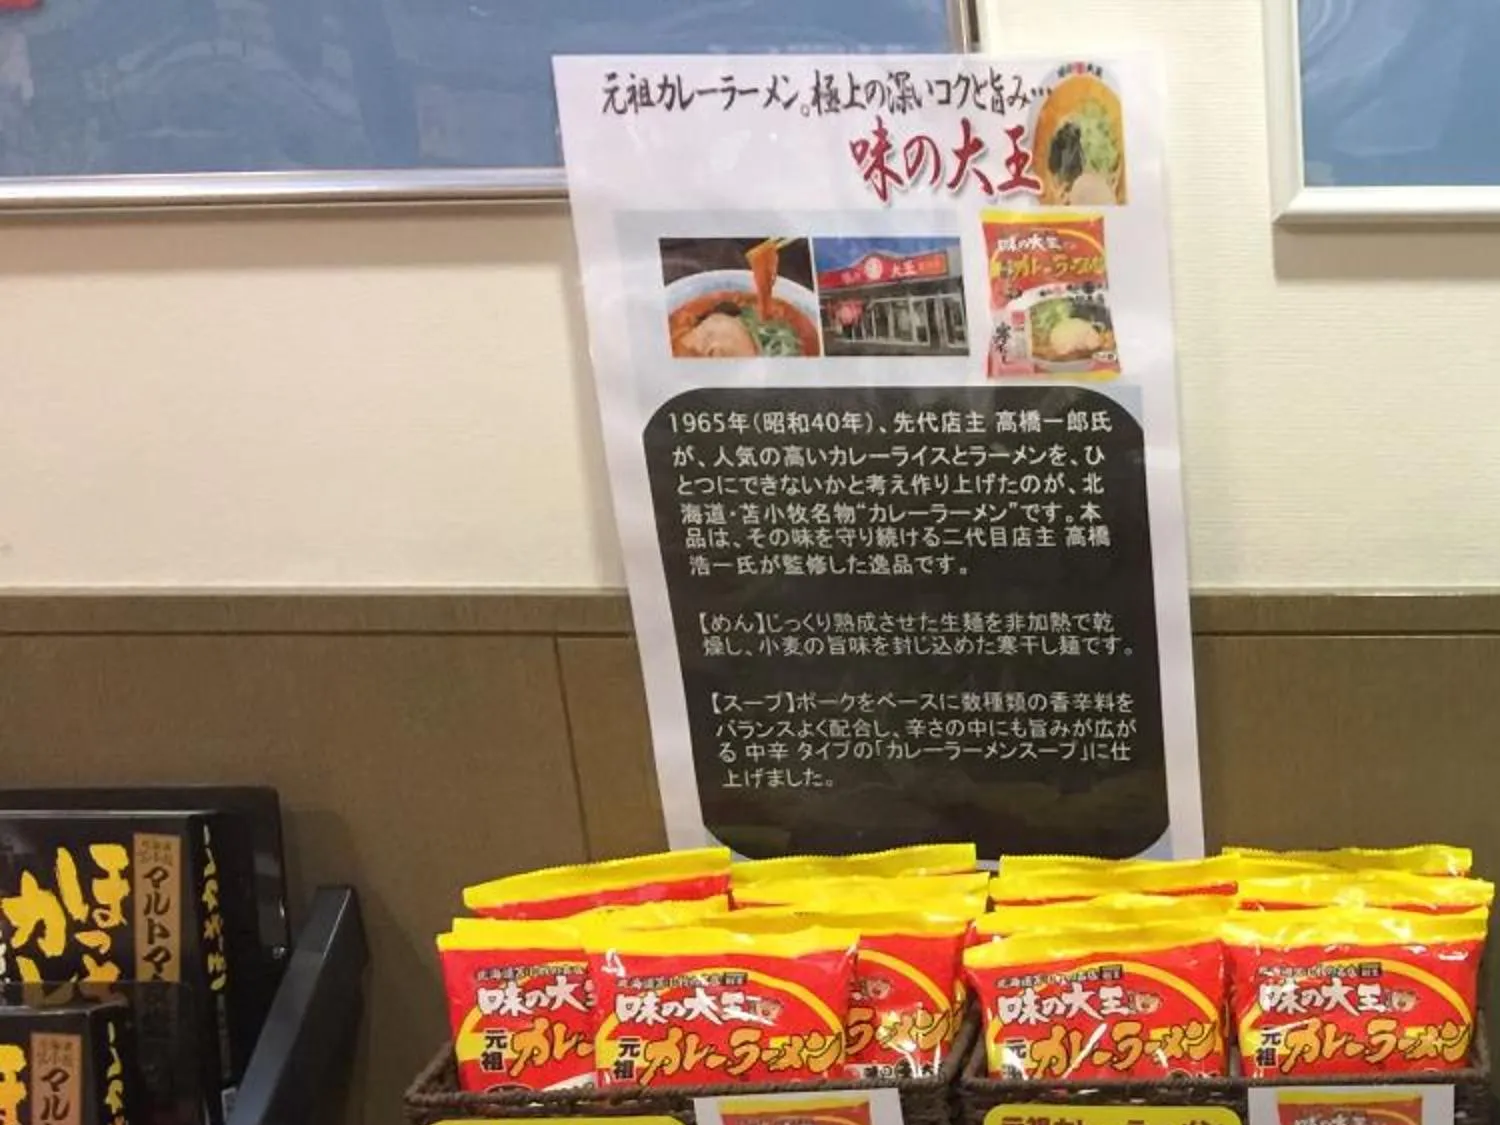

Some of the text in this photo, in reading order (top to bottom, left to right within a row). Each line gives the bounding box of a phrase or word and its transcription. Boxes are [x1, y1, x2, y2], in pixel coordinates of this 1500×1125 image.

[849, 117, 1043, 201] 味の大王
[673, 444, 1105, 468] が、人気の高いカレーライスとラーメンを、ひ
[676, 473, 1105, 496] とつにできないかと考え作り上げたのが、北
[722, 768, 835, 790] 上げました。
[142, 866, 172, 982] マルトマ
[614, 985, 757, 1027] 味の大王
[999, 984, 1126, 1024] 味の大王
[1258, 980, 1387, 1018] 味の大王
[614, 1037, 642, 1081] 元祖
[640, 1026, 843, 1086] カレーラーメン
[1030, 1019, 1218, 1079] カレーラーメン
[1282, 1018, 1471, 1074] カレーラーメン
